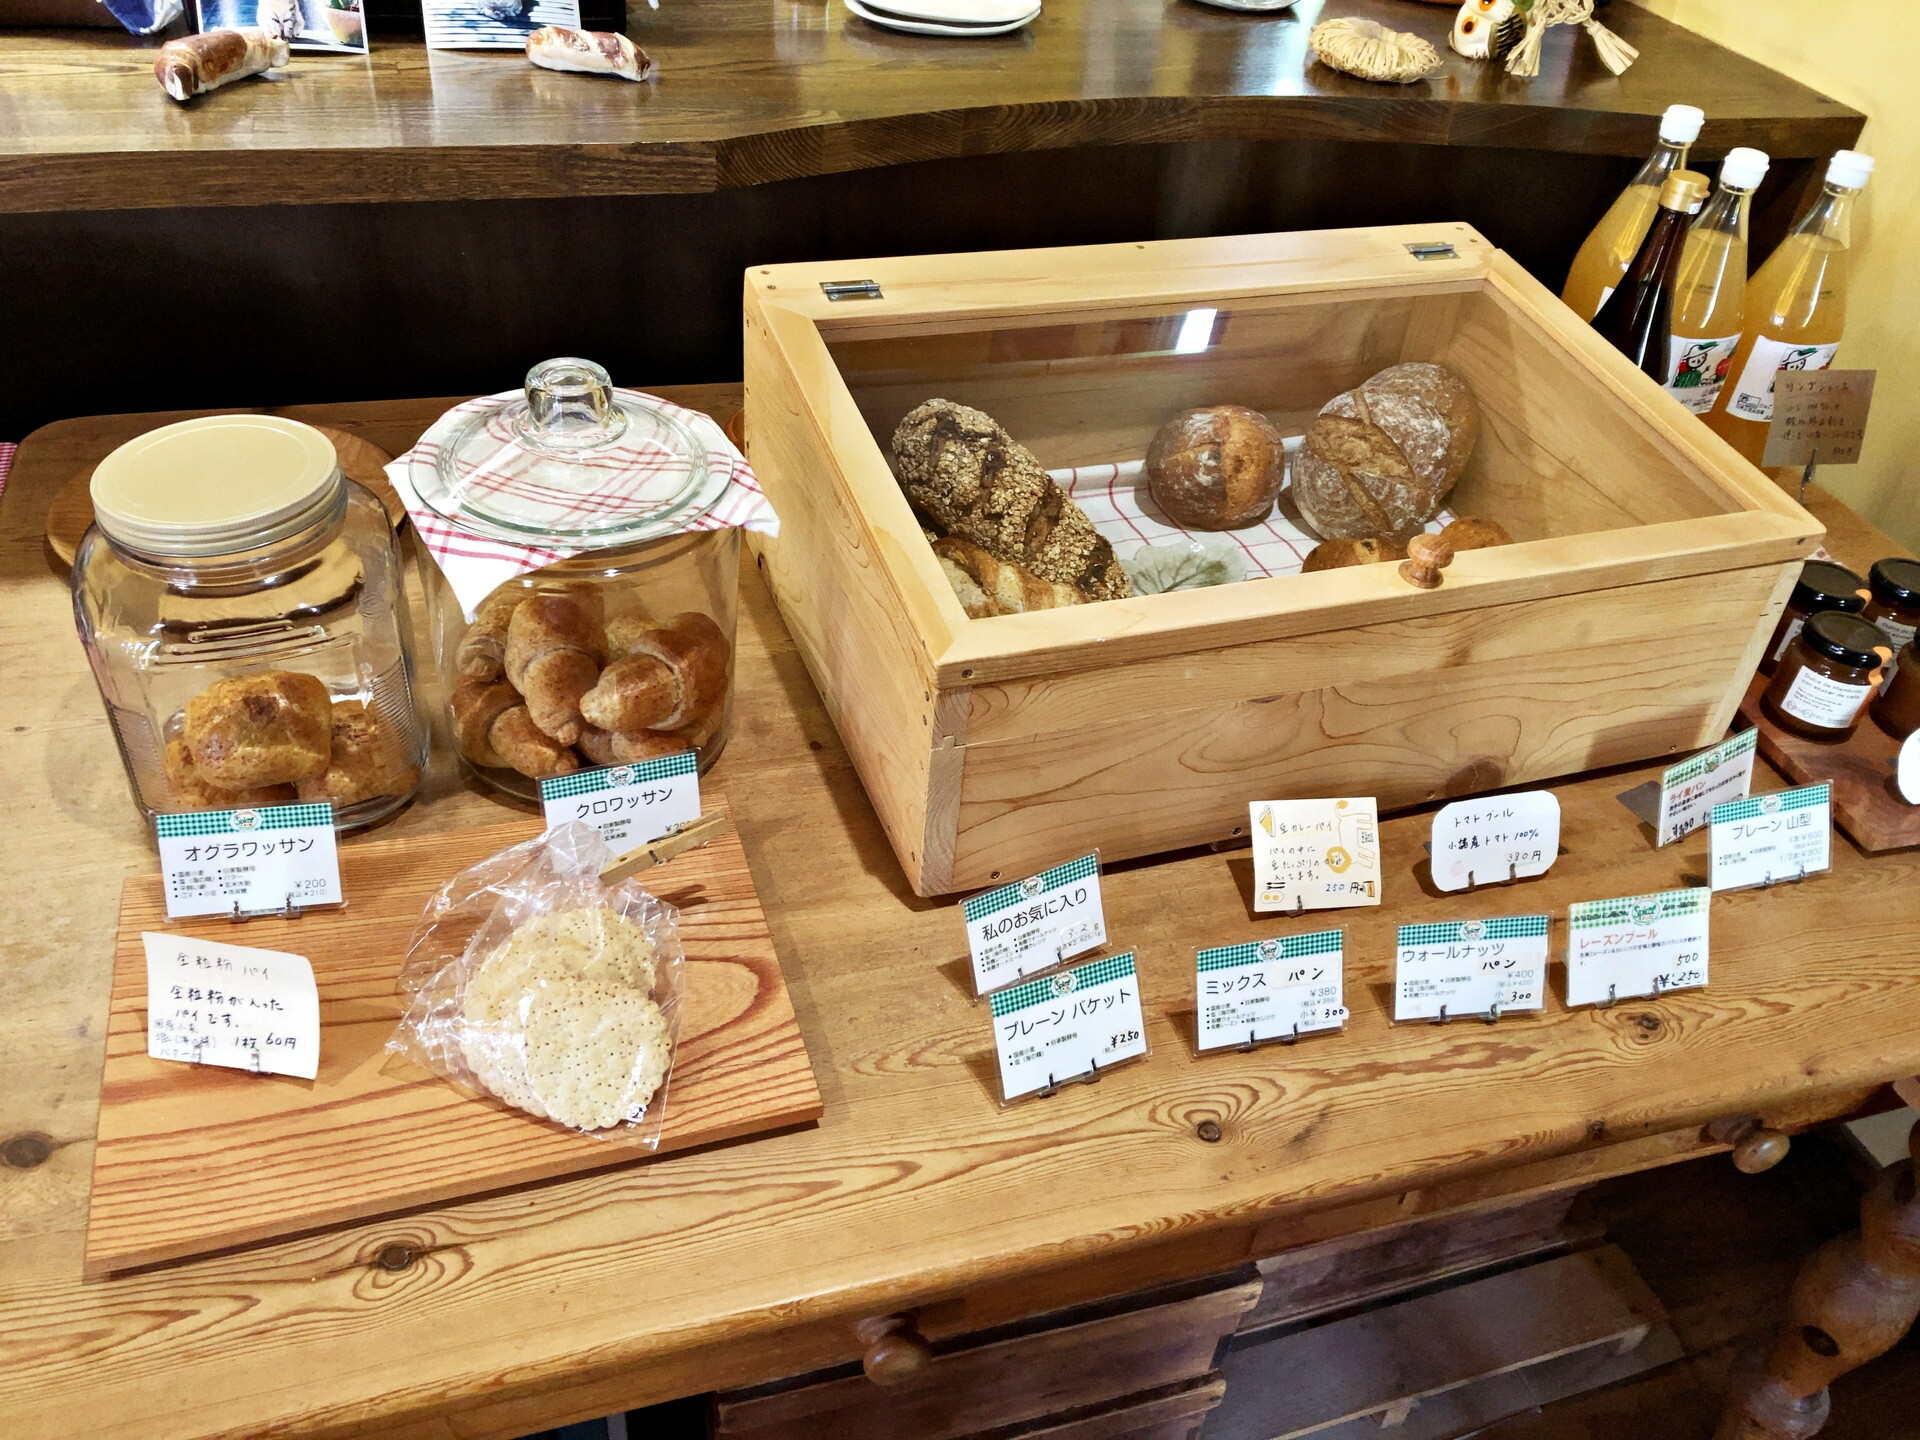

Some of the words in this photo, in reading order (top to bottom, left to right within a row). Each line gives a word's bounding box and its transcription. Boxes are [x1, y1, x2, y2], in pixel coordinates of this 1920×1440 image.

[576, 788, 673, 819] クロワッサン
[1732, 820, 1782, 840] プレーン
[1786, 812, 1812, 829] 山型
[184, 838, 314, 862] オグラワッサン
[294, 878, 327, 889] ¥200
[982, 888, 1087, 942] 私のお気に入り
[1579, 928, 1658, 949] レーズンブール
[1402, 943, 1505, 963] ウォールナッツ
[1676, 952, 1699, 967] 500
[243, 966, 269, 980] パイ
[1482, 959, 1516, 970] パン
[1206, 972, 1267, 995] ミックス
[1288, 967, 1324, 982] パン
[1506, 970, 1534, 979] ¥400
[1310, 986, 1337, 997] ¥380
[1511, 991, 1532, 1002] 300
[1004, 1009, 1065, 1041] プレーン
[1072, 988, 1131, 1019] バケット
[1324, 1008, 1345, 1019] 300
[266, 1032, 296, 1049] 60円
[1111, 1030, 1140, 1048] ¥250
